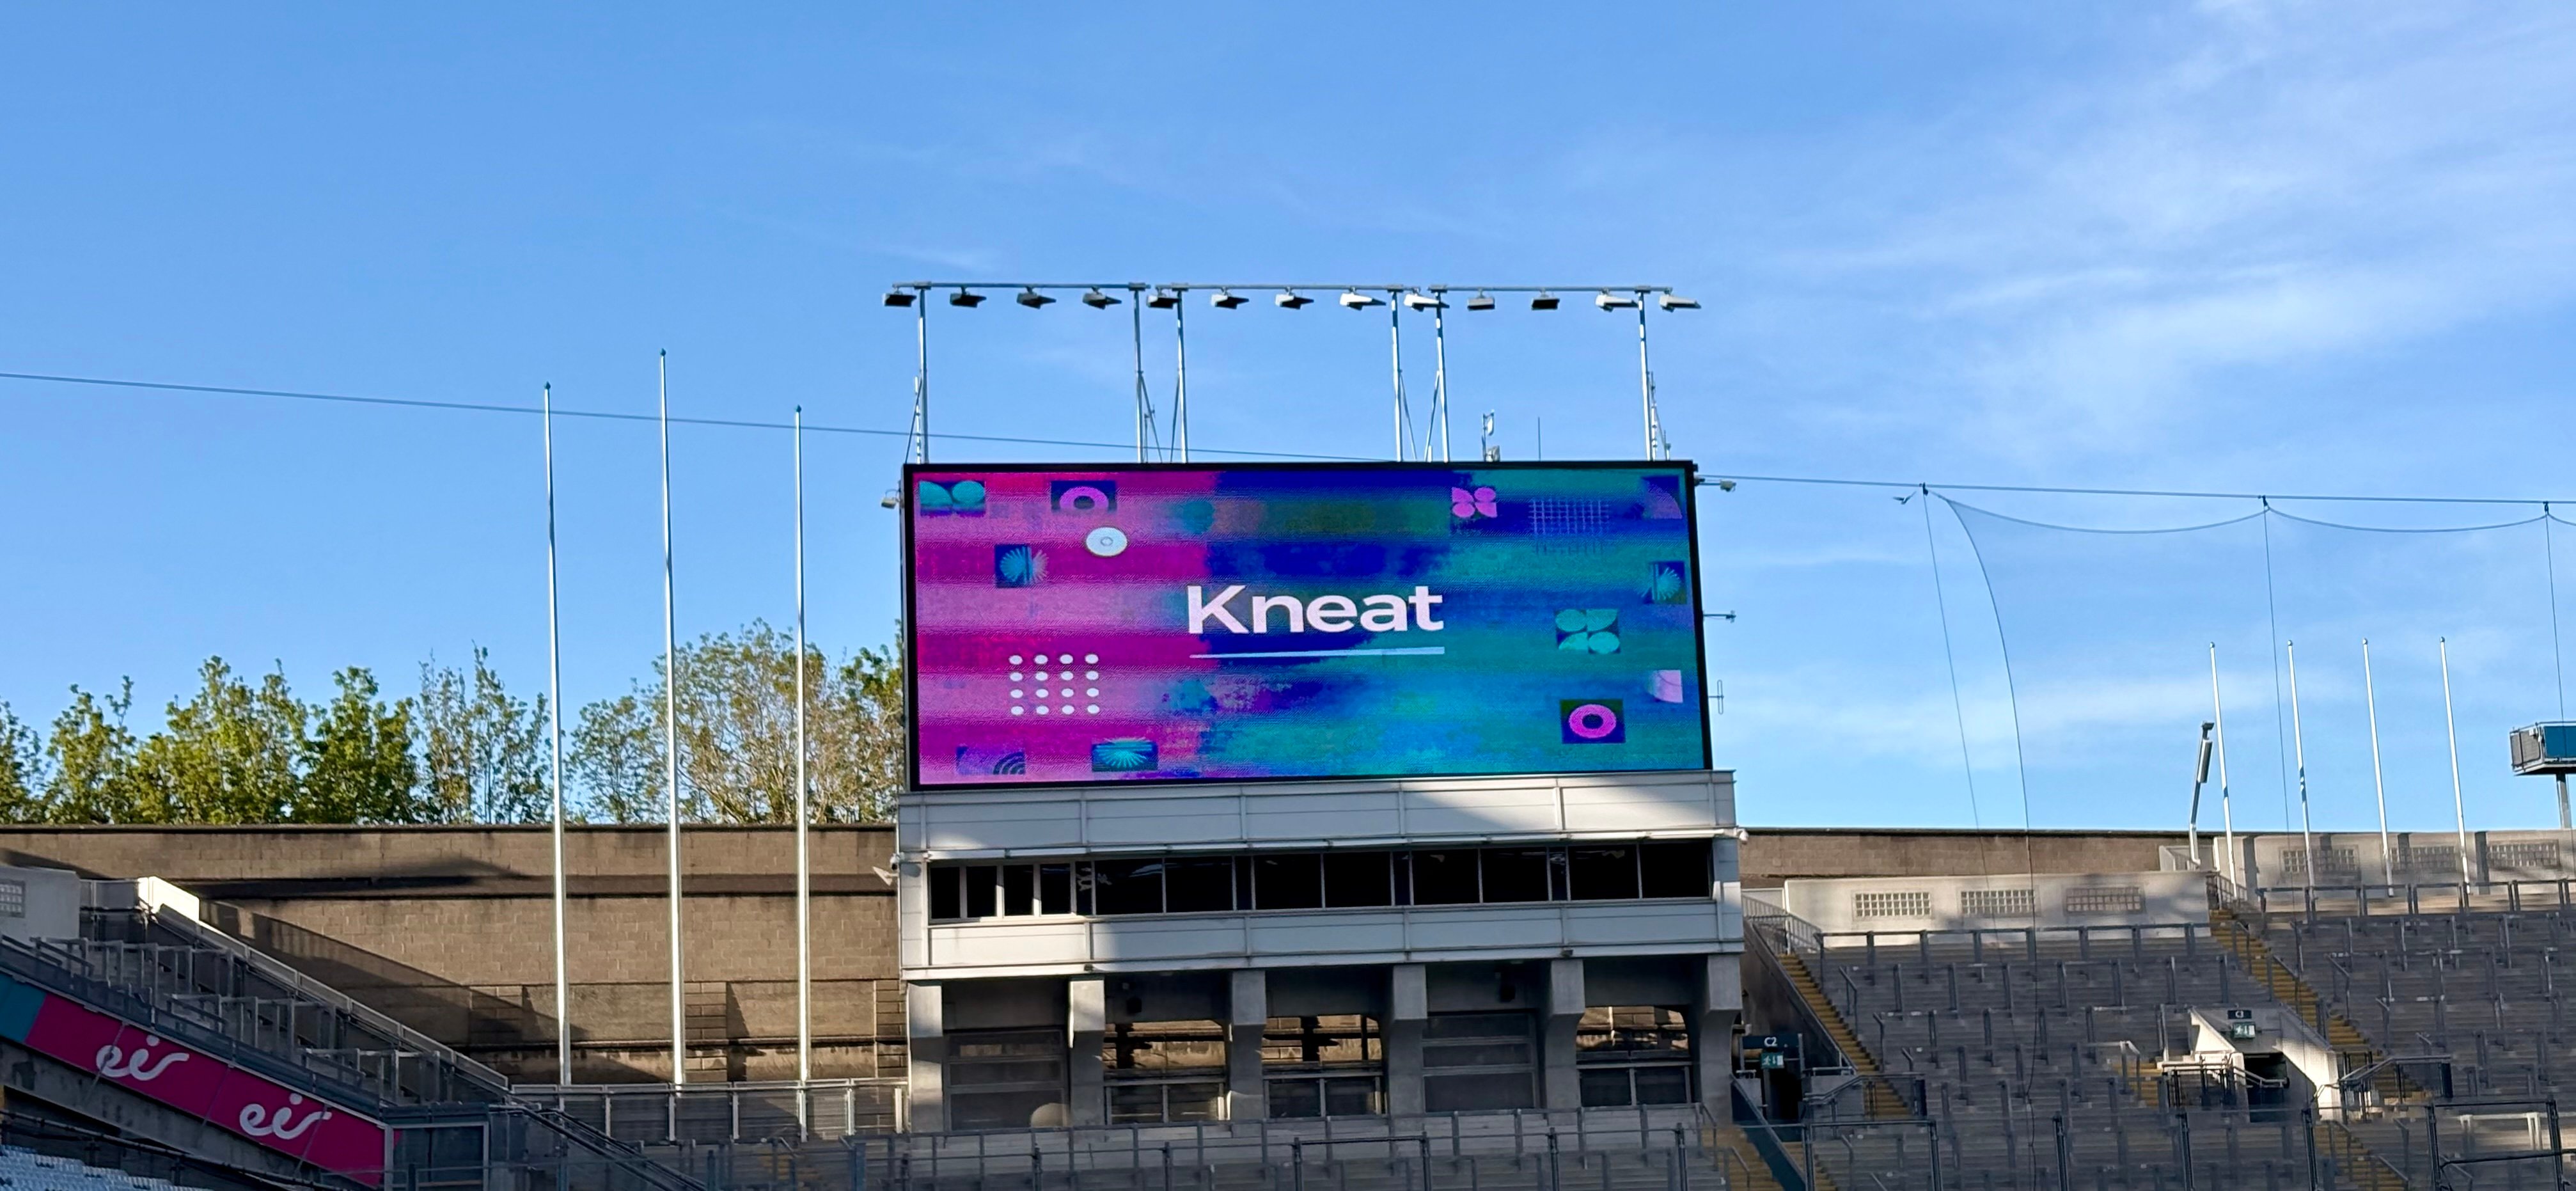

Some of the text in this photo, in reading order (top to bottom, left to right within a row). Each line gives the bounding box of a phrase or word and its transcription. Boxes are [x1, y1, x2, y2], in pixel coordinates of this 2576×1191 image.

[1187, 585, 1445, 634] Kneat
[96, 1034, 190, 1081] eir
[1764, 1036, 1778, 1047] C2
[239, 1092, 333, 1140] eir
